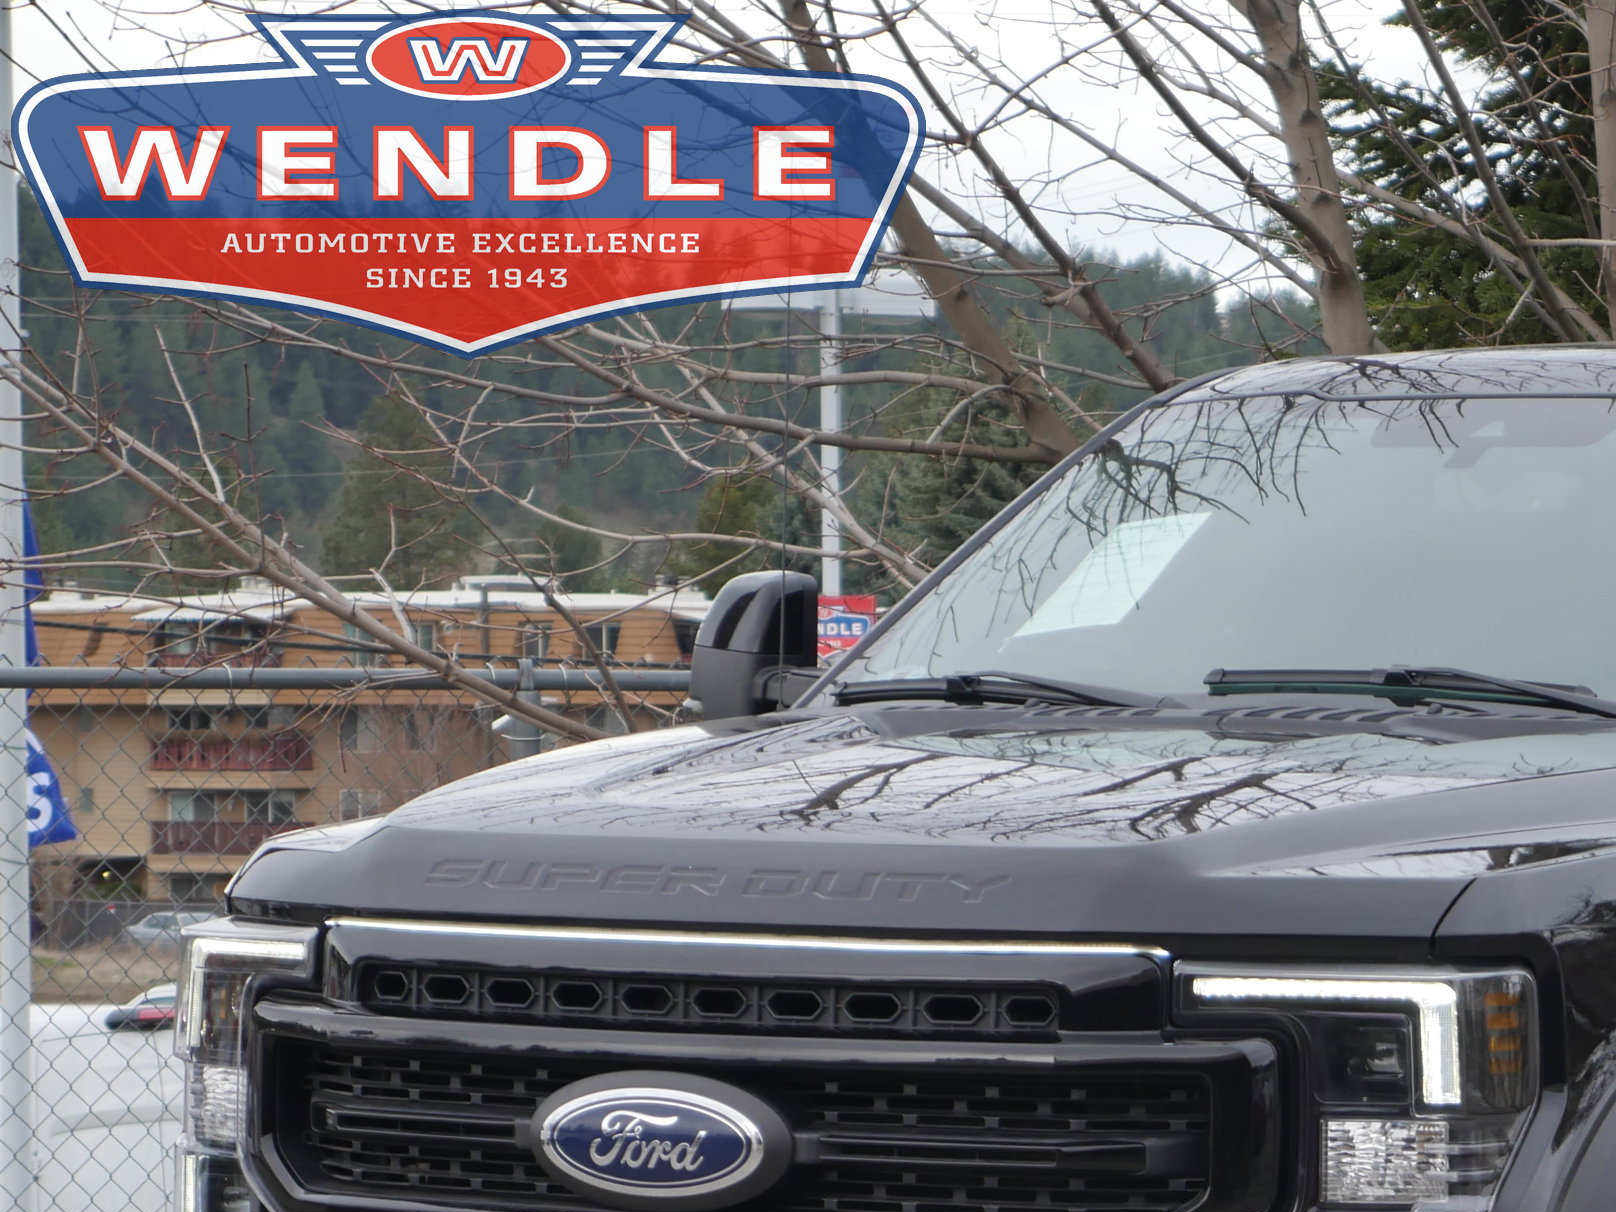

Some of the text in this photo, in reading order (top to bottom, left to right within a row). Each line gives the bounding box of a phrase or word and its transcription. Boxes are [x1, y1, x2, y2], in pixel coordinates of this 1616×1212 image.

[425, 858, 1012, 903] SUPER DUTY
[589, 1110, 707, 1171] Ford
